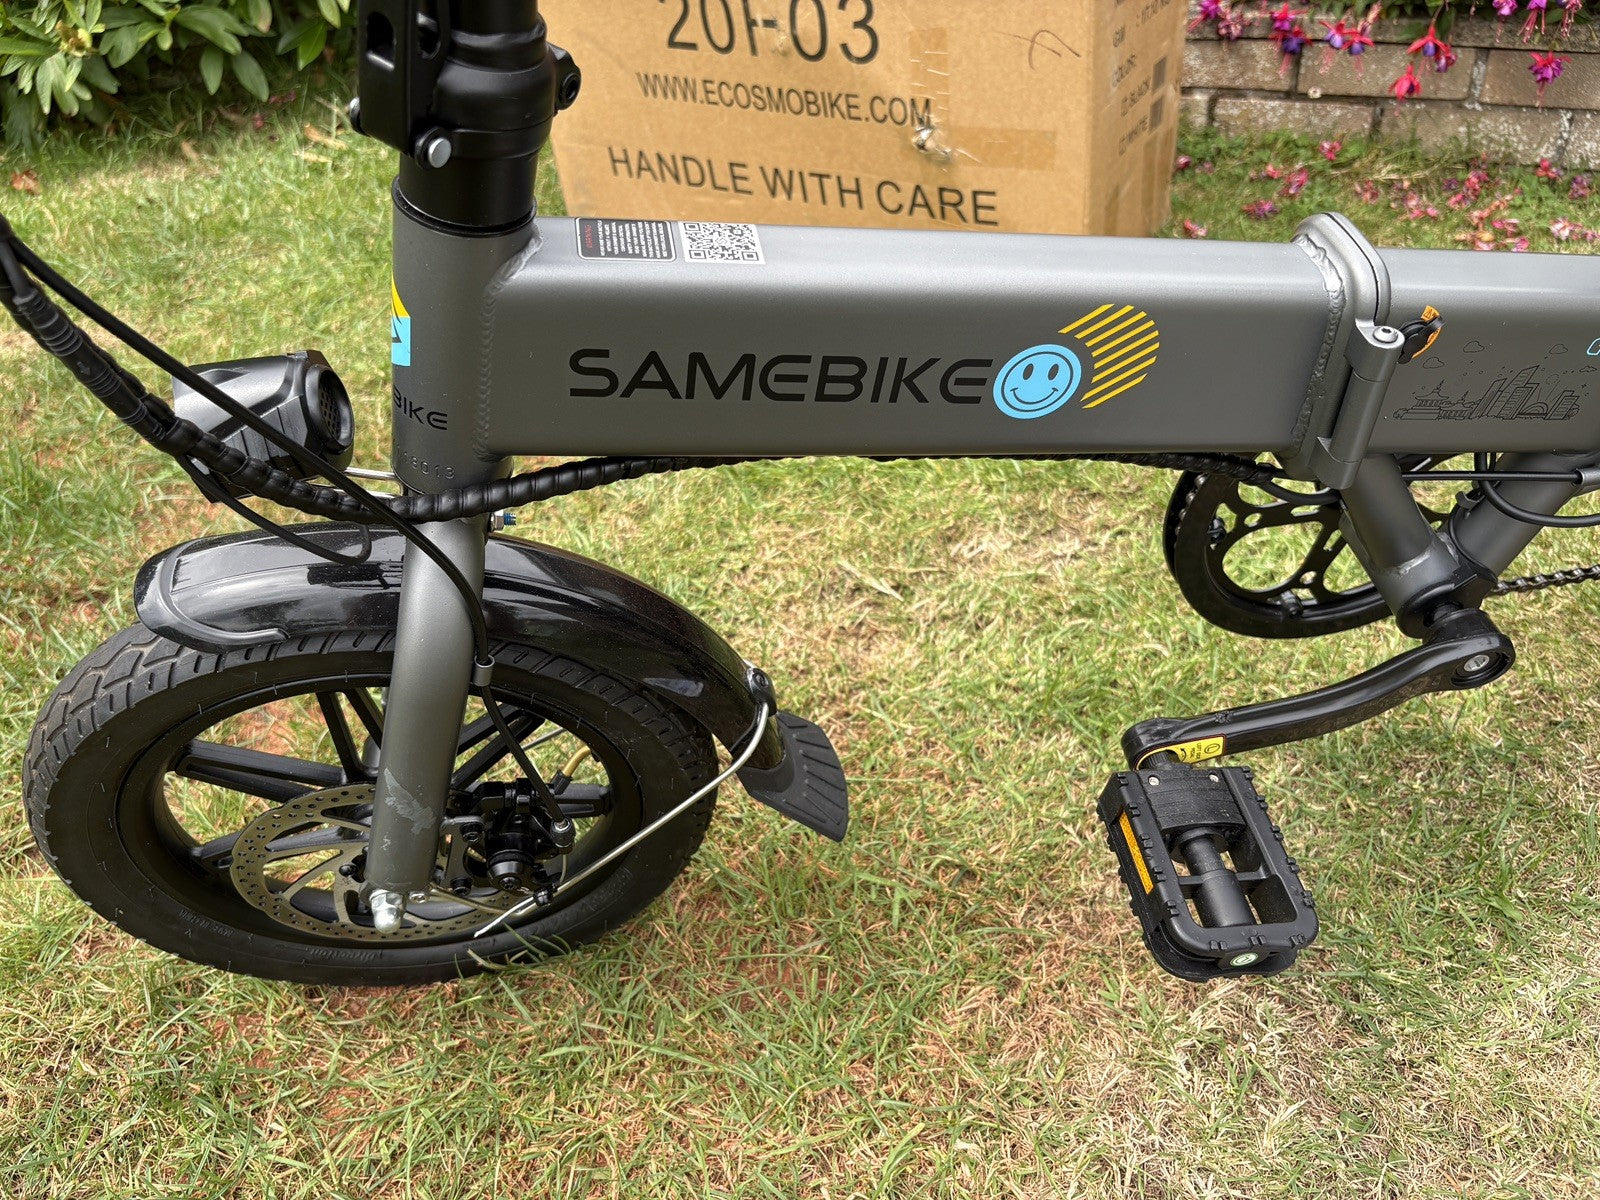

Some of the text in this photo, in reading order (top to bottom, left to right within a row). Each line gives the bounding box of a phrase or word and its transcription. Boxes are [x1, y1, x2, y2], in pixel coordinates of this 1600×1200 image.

[637, 72, 933, 128] WWW.ECOSMOBIKE.COM
[608, 146, 998, 227] HANDLE WITH CARE
[569, 348, 993, 404] SAMEBIKE
